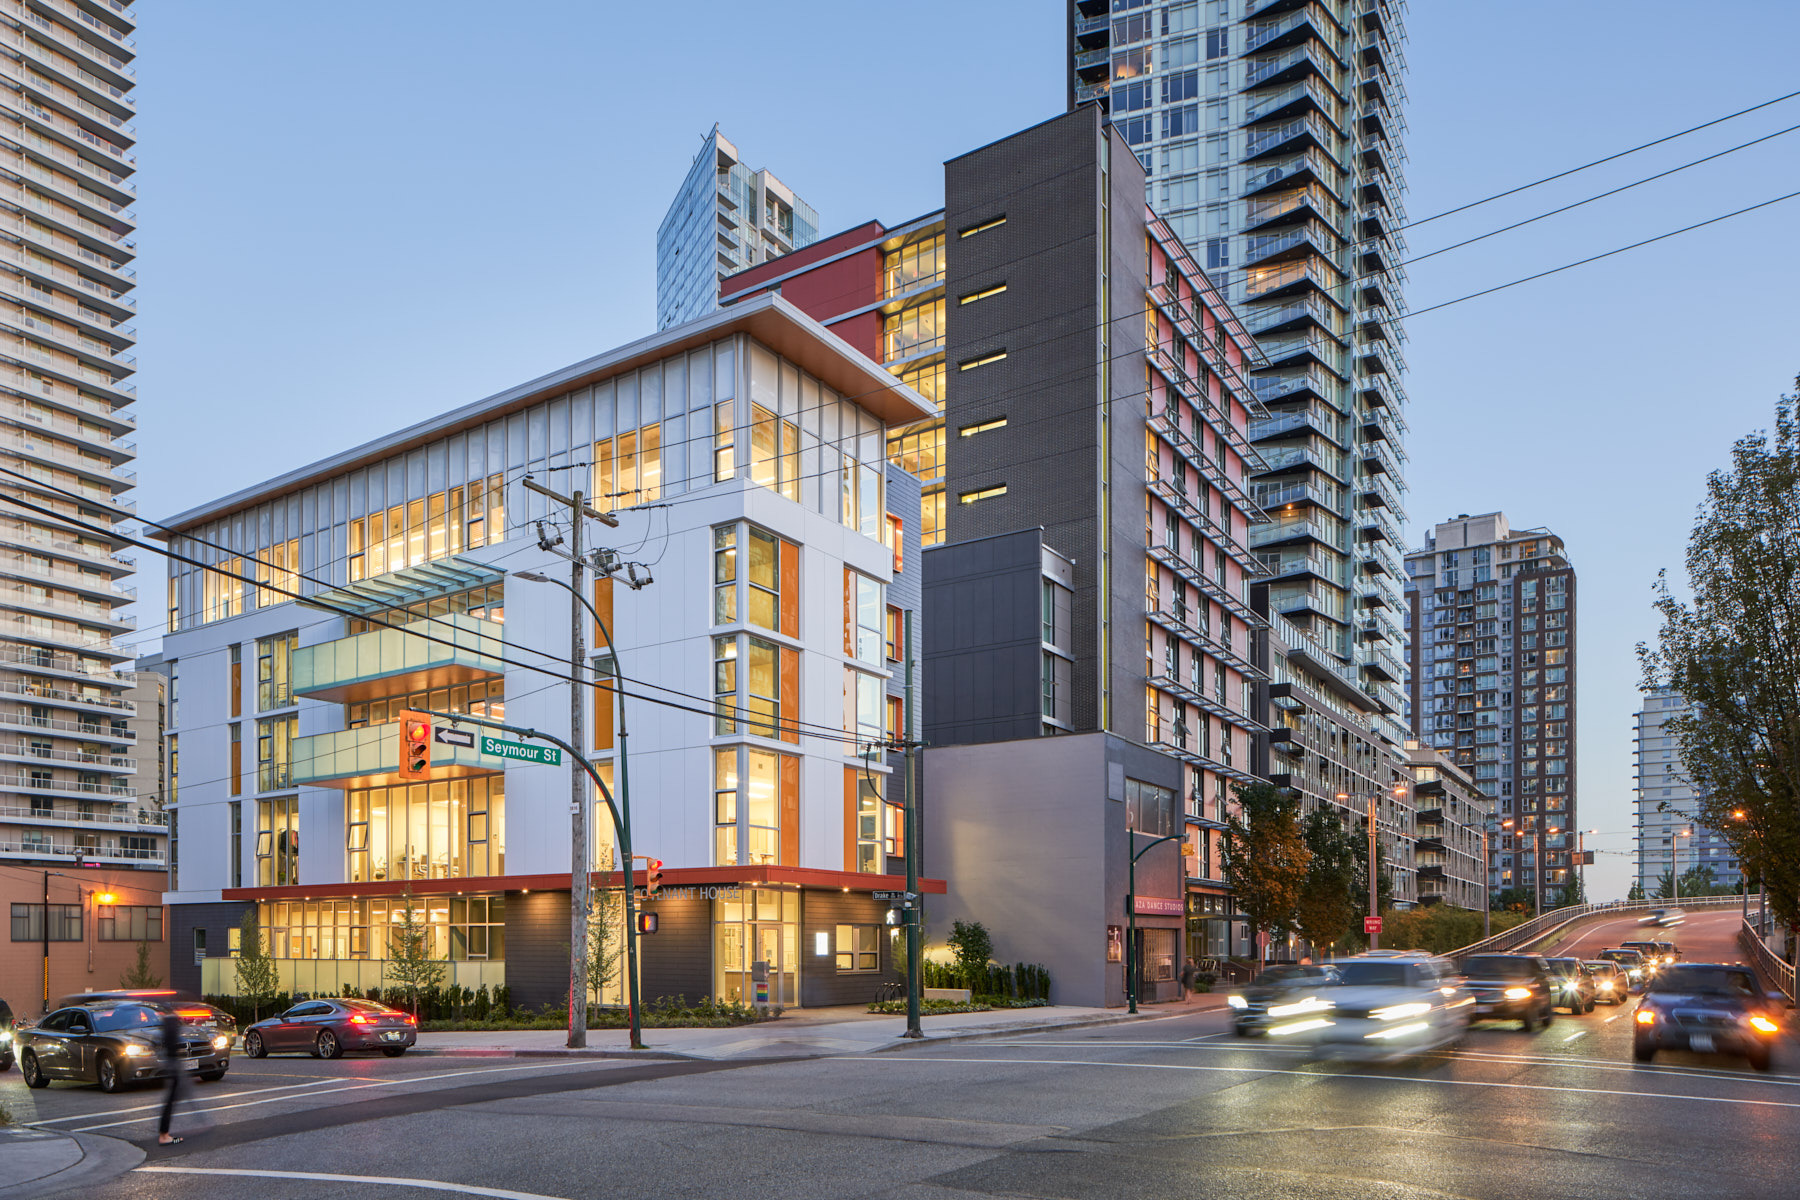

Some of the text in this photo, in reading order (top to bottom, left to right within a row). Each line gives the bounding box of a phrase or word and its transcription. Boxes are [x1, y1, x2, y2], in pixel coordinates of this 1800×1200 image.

[486, 739, 557, 762] Seymour St
[633, 886, 740, 901] COENANT HOUSE
[1147, 902, 1163, 910] DANCE
[1164, 902, 1184, 911] STUDIOS
